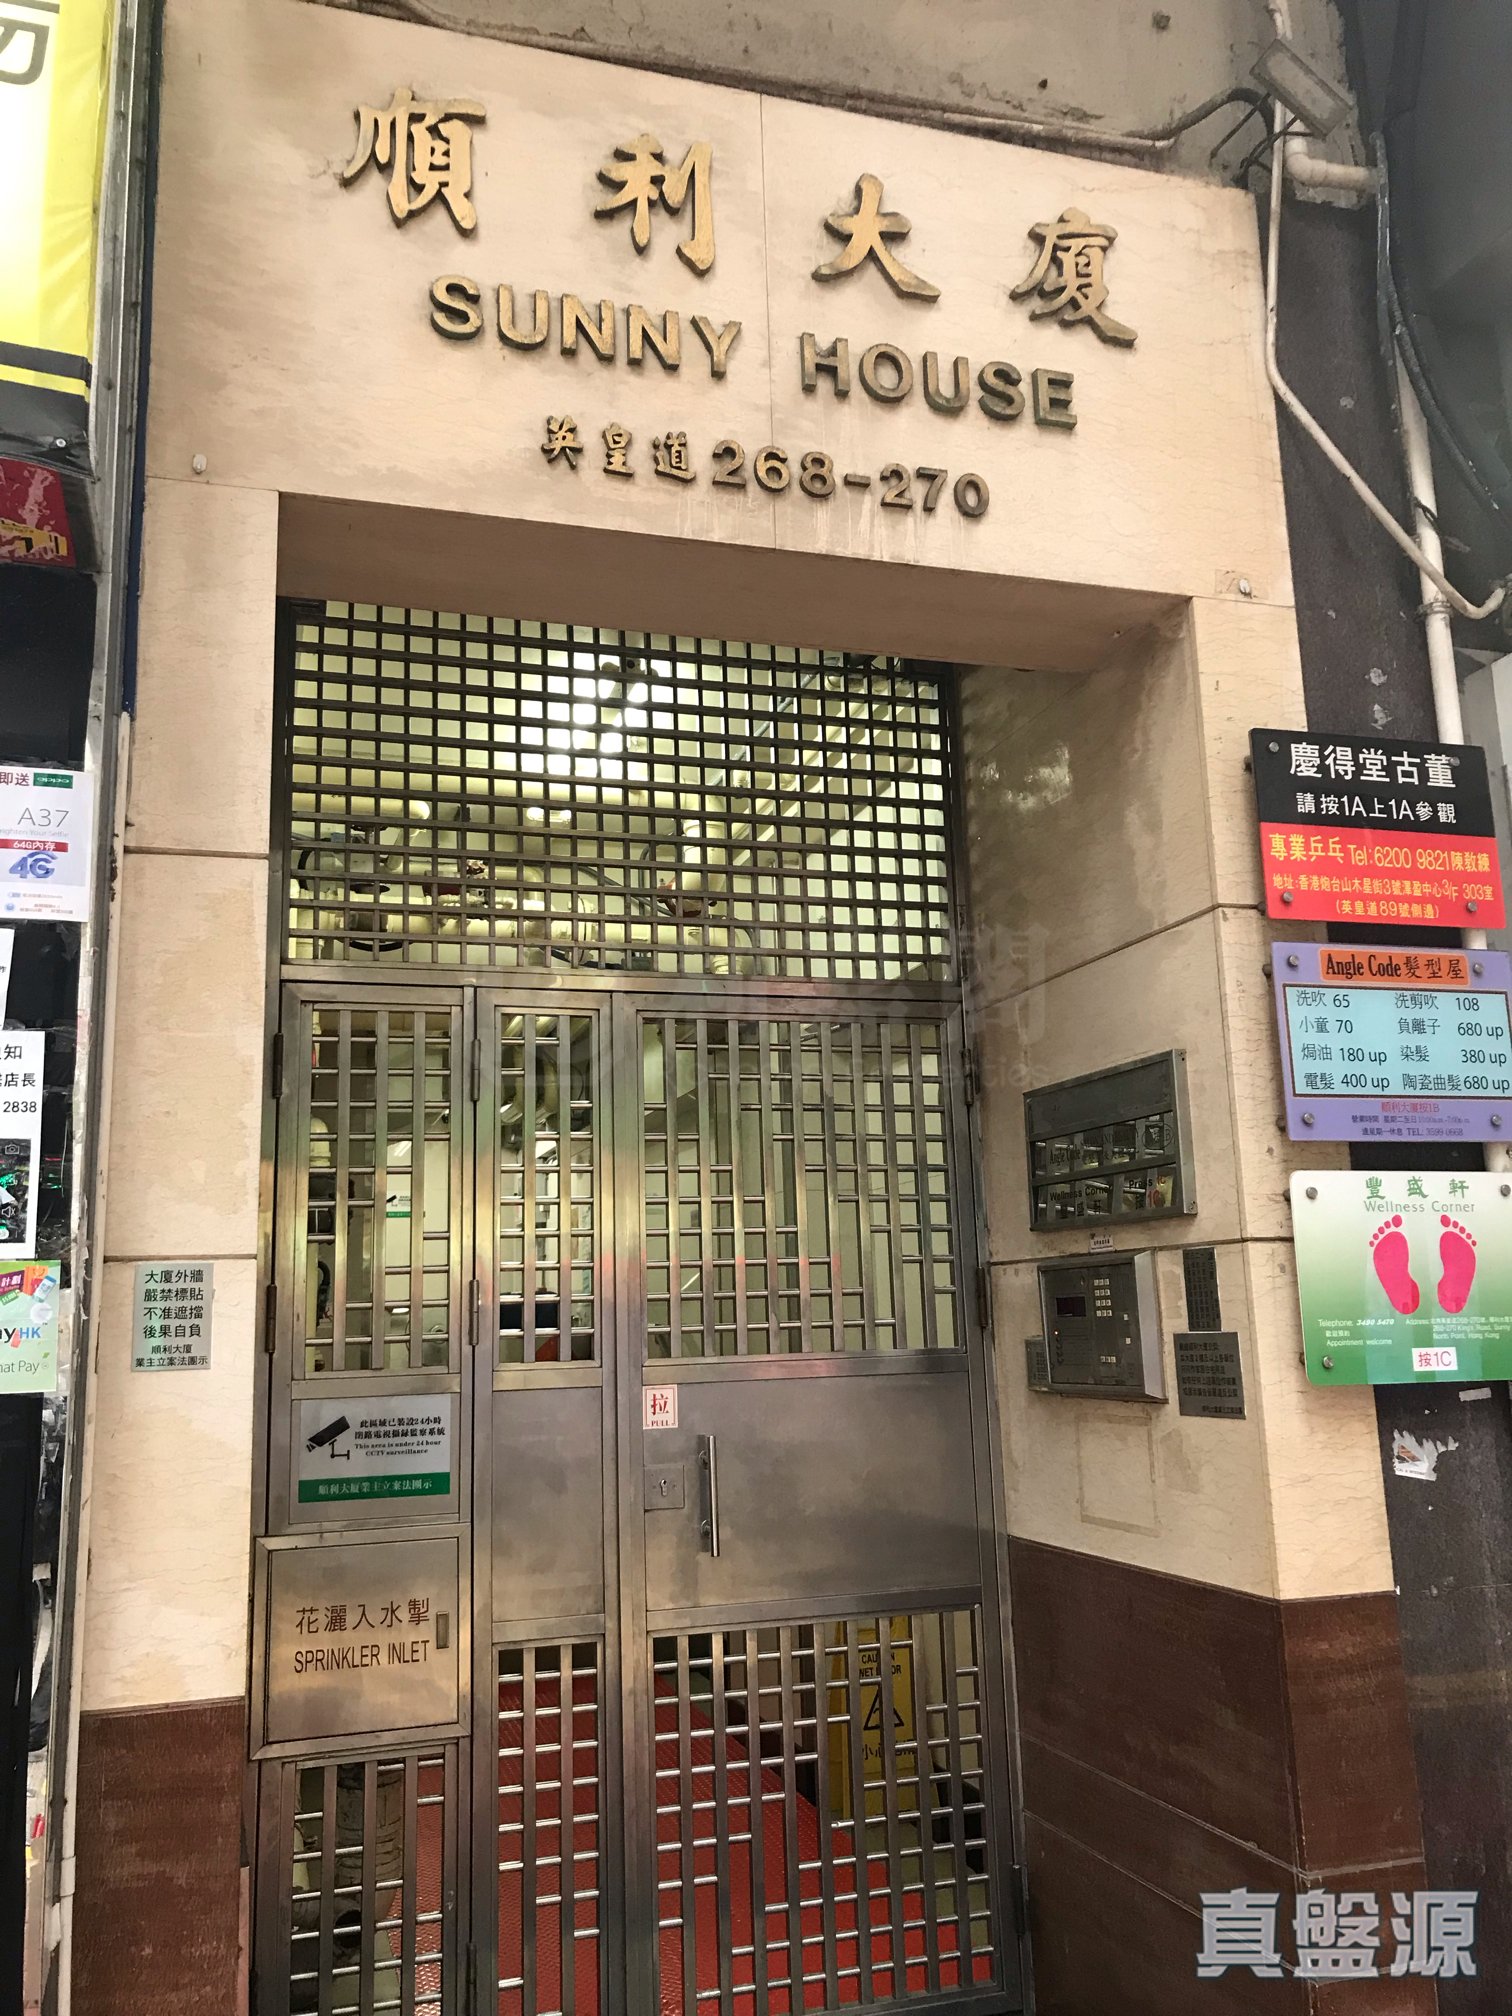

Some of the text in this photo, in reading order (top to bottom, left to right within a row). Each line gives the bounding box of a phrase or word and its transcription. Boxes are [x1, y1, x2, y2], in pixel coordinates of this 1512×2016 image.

[340, 89, 1138, 347] 順利大廈
[430, 274, 1078, 430] SUNNY HOUSE
[1289, 742, 1457, 788] 慶得堂古董
[17, 807, 70, 828] A37
[1296, 792, 1456, 824] 請按1A上1A參觀
[8, 850, 58, 879] 4G
[1326, 953, 1465, 980] Angle Code 髮型屋
[1296, 989, 1350, 1008] 洗吹 65
[1395, 992, 1480, 1011] 洗剪吹 108
[1299, 1016, 1353, 1034] 小童 70
[1397, 1017, 1504, 1041] 負離子 680 up
[1301, 1043, 1387, 1066] 焗油 180 up
[1400, 1045, 1507, 1067] 染髮 380 up
[1303, 1072, 1390, 1092] 電髮 400 up
[1402, 1073, 1510, 1093] 陶瓷曲髮 680 up
[3, 1101, 37, 1113] 2838
[1364, 1200, 1475, 1213] Wellness Corner
[145, 1269, 204, 1284] 大廈外牆
[143, 1287, 204, 1302] 嚴禁標貼
[143, 1305, 204, 1320] 不准遮擋
[143, 1323, 202, 1339] 後果自負
[151, 1344, 193, 1354] 順利大廈
[18, 1361, 40, 1375] Pay
[1418, 1351, 1452, 1368] 按1C
[651, 1393, 669, 1416] 拉
[386, 1448, 428, 1456] surveillance
[296, 1597, 430, 1635] 花灑入水掣
[294, 1640, 430, 1674] SPRINKLER INLET
